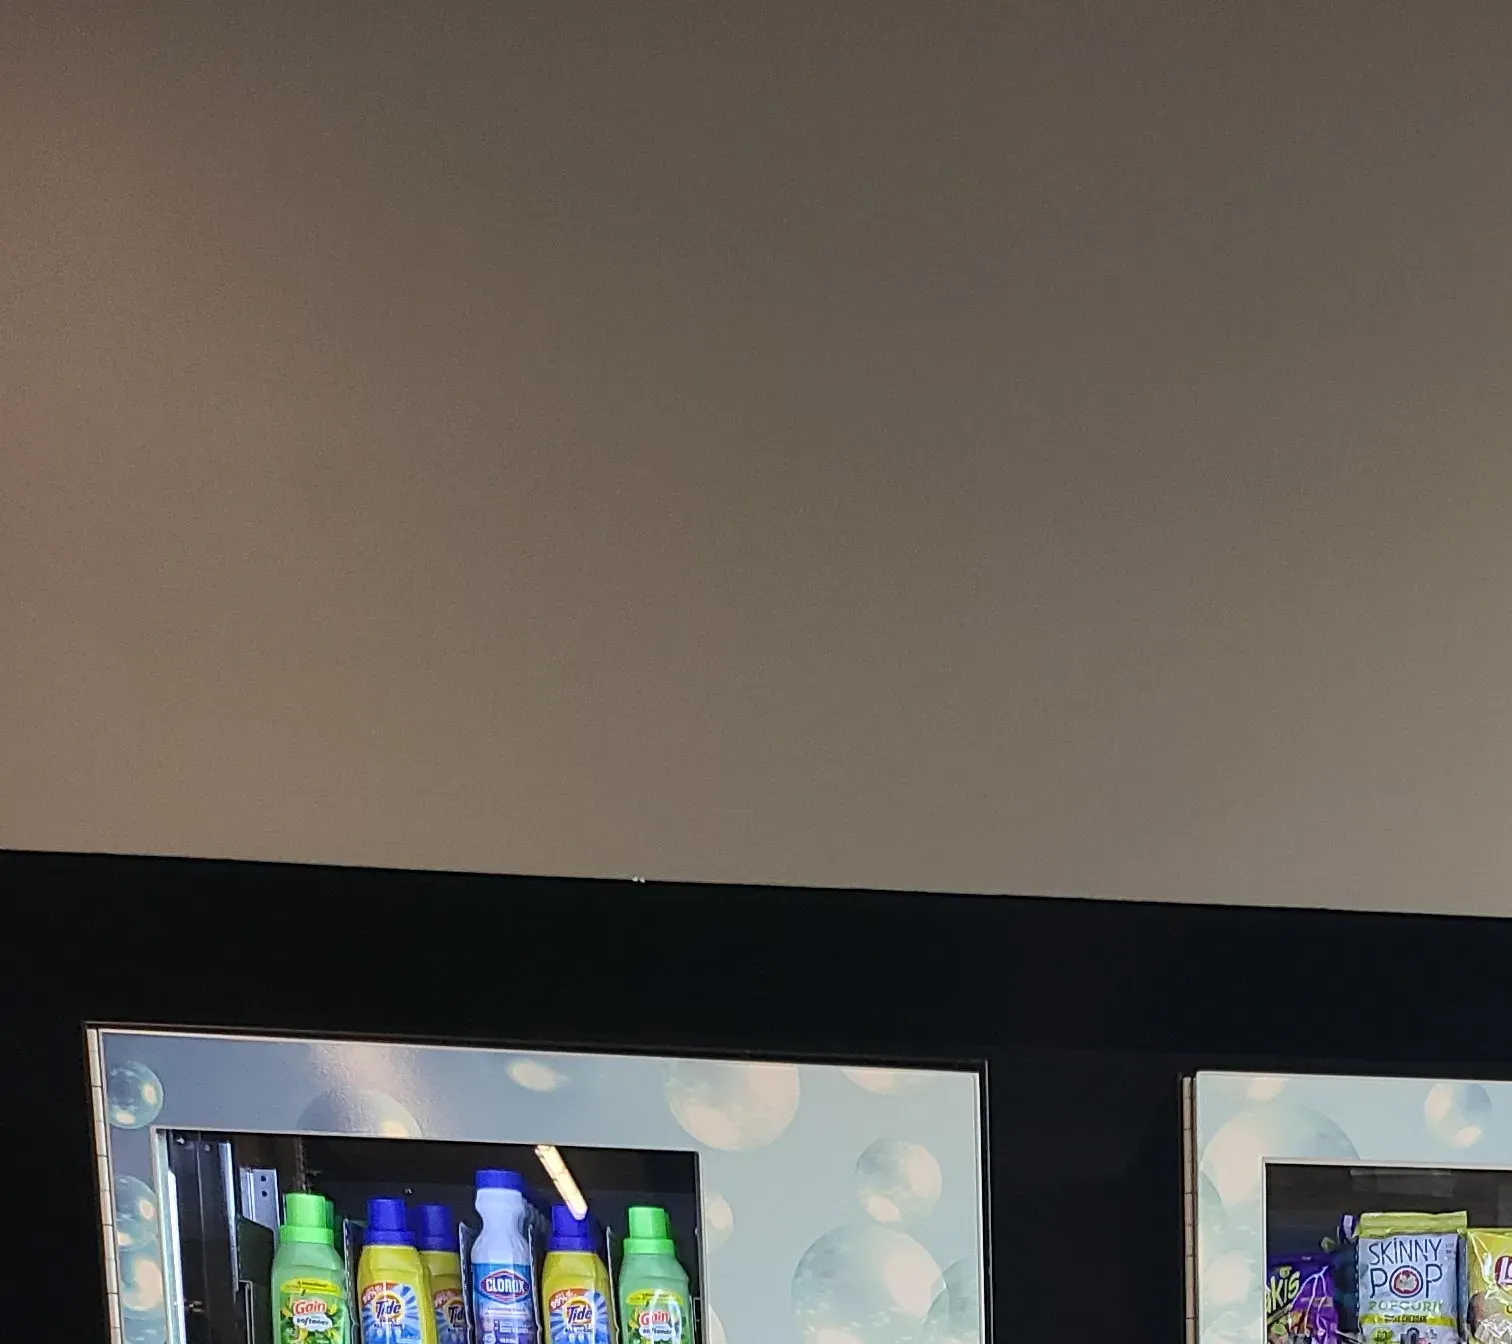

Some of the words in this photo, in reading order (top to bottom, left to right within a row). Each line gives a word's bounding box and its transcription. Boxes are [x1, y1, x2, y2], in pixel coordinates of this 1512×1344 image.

[1369, 1238, 1442, 1266] SKINNY
[486, 1277, 525, 1293] CLOROX
[1369, 1263, 1443, 1299] POP
[295, 1300, 327, 1314] Gain
[375, 1300, 401, 1318] Tide
[567, 1304, 592, 1323] Tide
